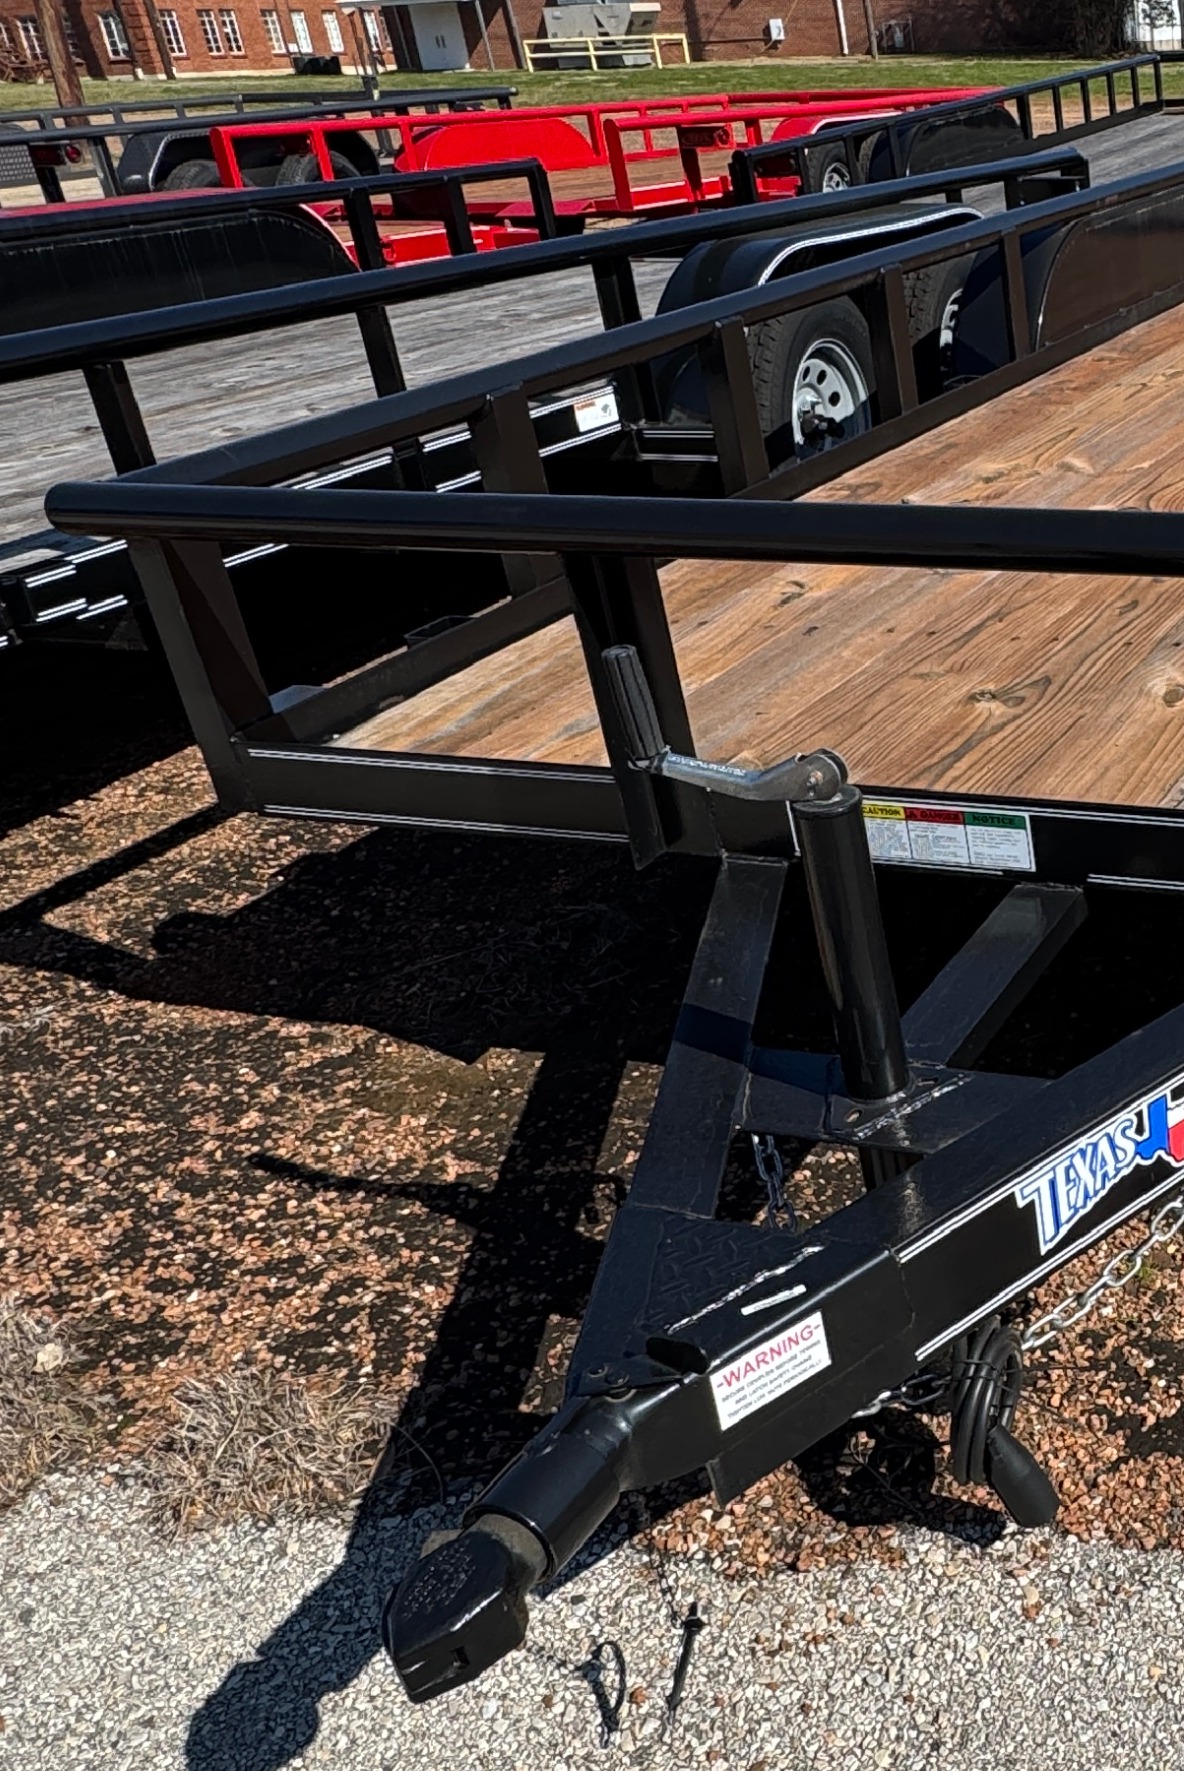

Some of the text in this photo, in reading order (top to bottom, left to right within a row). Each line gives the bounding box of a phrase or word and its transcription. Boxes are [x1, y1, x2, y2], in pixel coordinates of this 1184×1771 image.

[862, 806, 902, 817] CAUTION
[972, 814, 1016, 826] NOTICE
[1016, 1116, 1139, 1251] TEXAS
